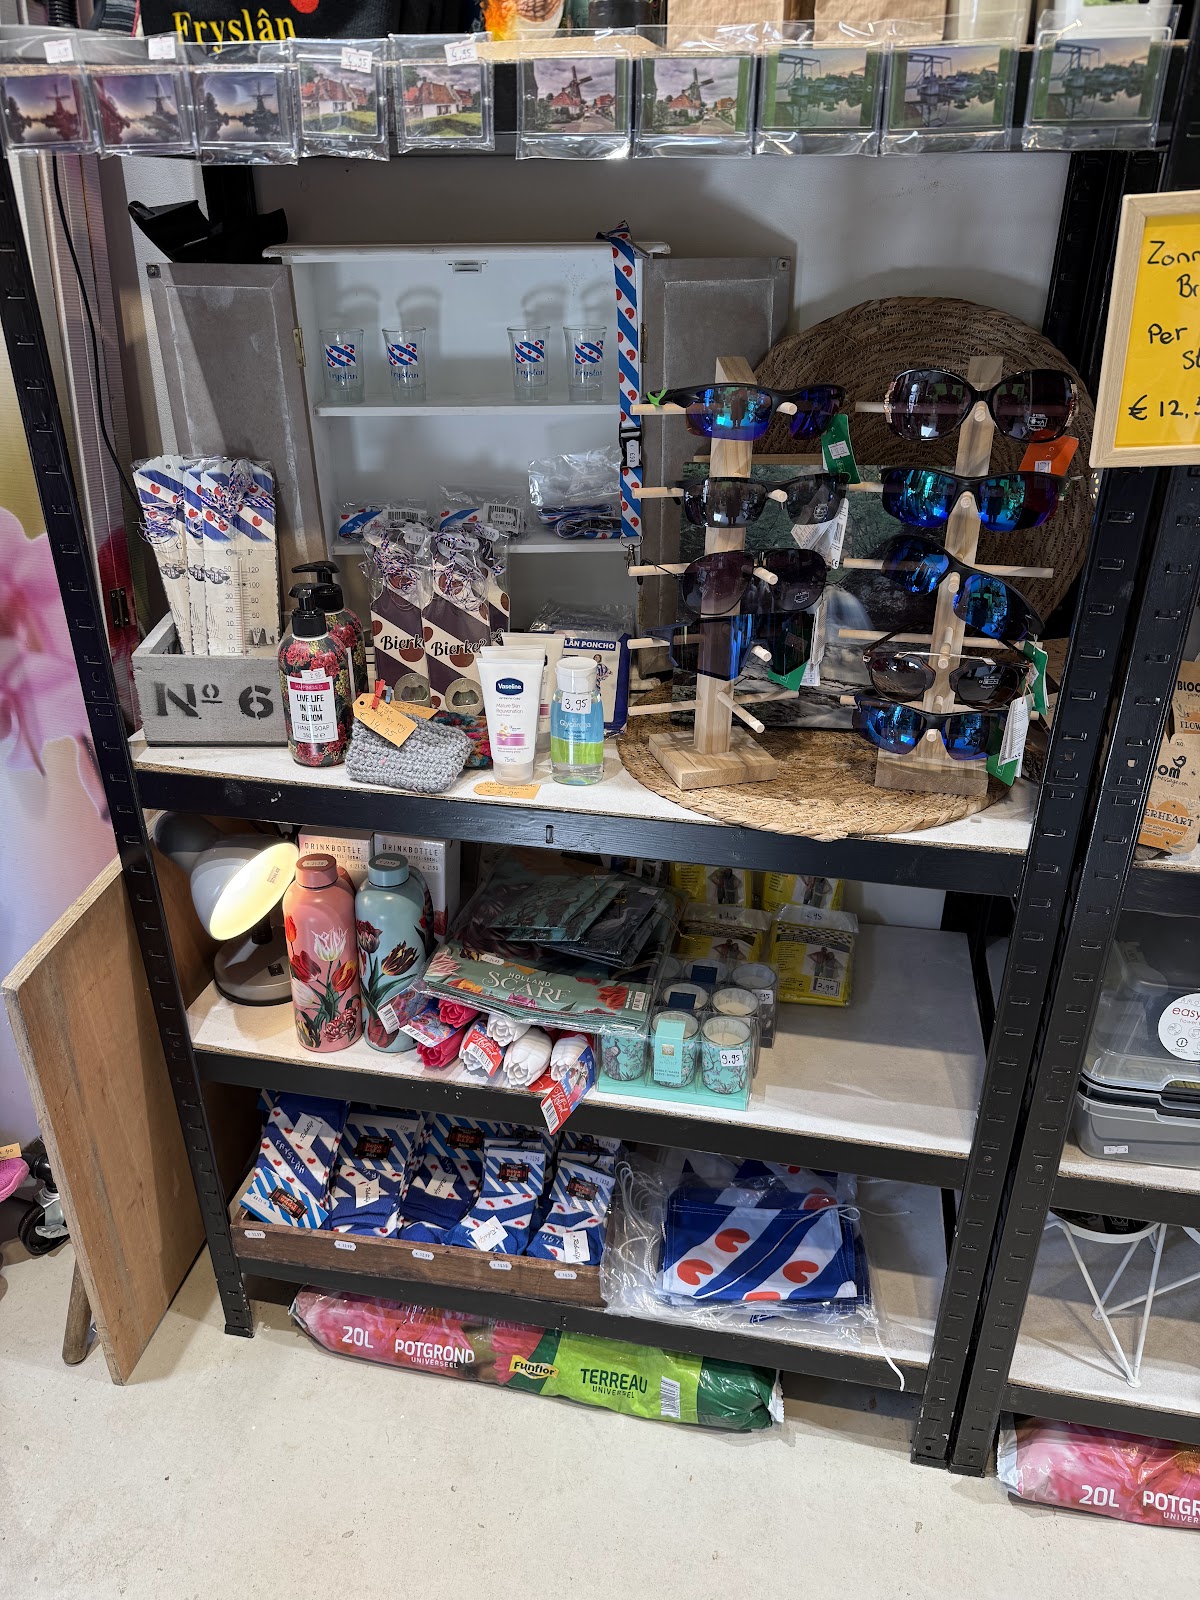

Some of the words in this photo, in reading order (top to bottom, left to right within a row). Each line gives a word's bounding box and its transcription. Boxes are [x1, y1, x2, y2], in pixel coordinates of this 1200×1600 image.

[172, 8, 296, 54] Fryslân
[1147, 323, 1188, 345] Per
[1128, 394, 1148, 421] €
[431, 639, 486, 656] Bierke?
[581, 641, 615, 650] PONCHO
[239, 685, 274, 719] 6
[297, 694, 310, 702] LIVE
[311, 694, 324, 703] LIFE
[305, 842, 362, 854] DRINKBOTTLE
[382, 843, 439, 856] DRINKBOTTLE
[482, 970, 571, 1005] SCARF
[508, 972, 551, 987] HOLLAND
[342, 1326, 374, 1349] 20L
[395, 1339, 475, 1364] POTGROND
[411, 1356, 459, 1369] UNIVERSEEL
[513, 1361, 555, 1376] Funflor
[580, 1368, 648, 1394] TERREAU
[1079, 1484, 1120, 1508] 20L
